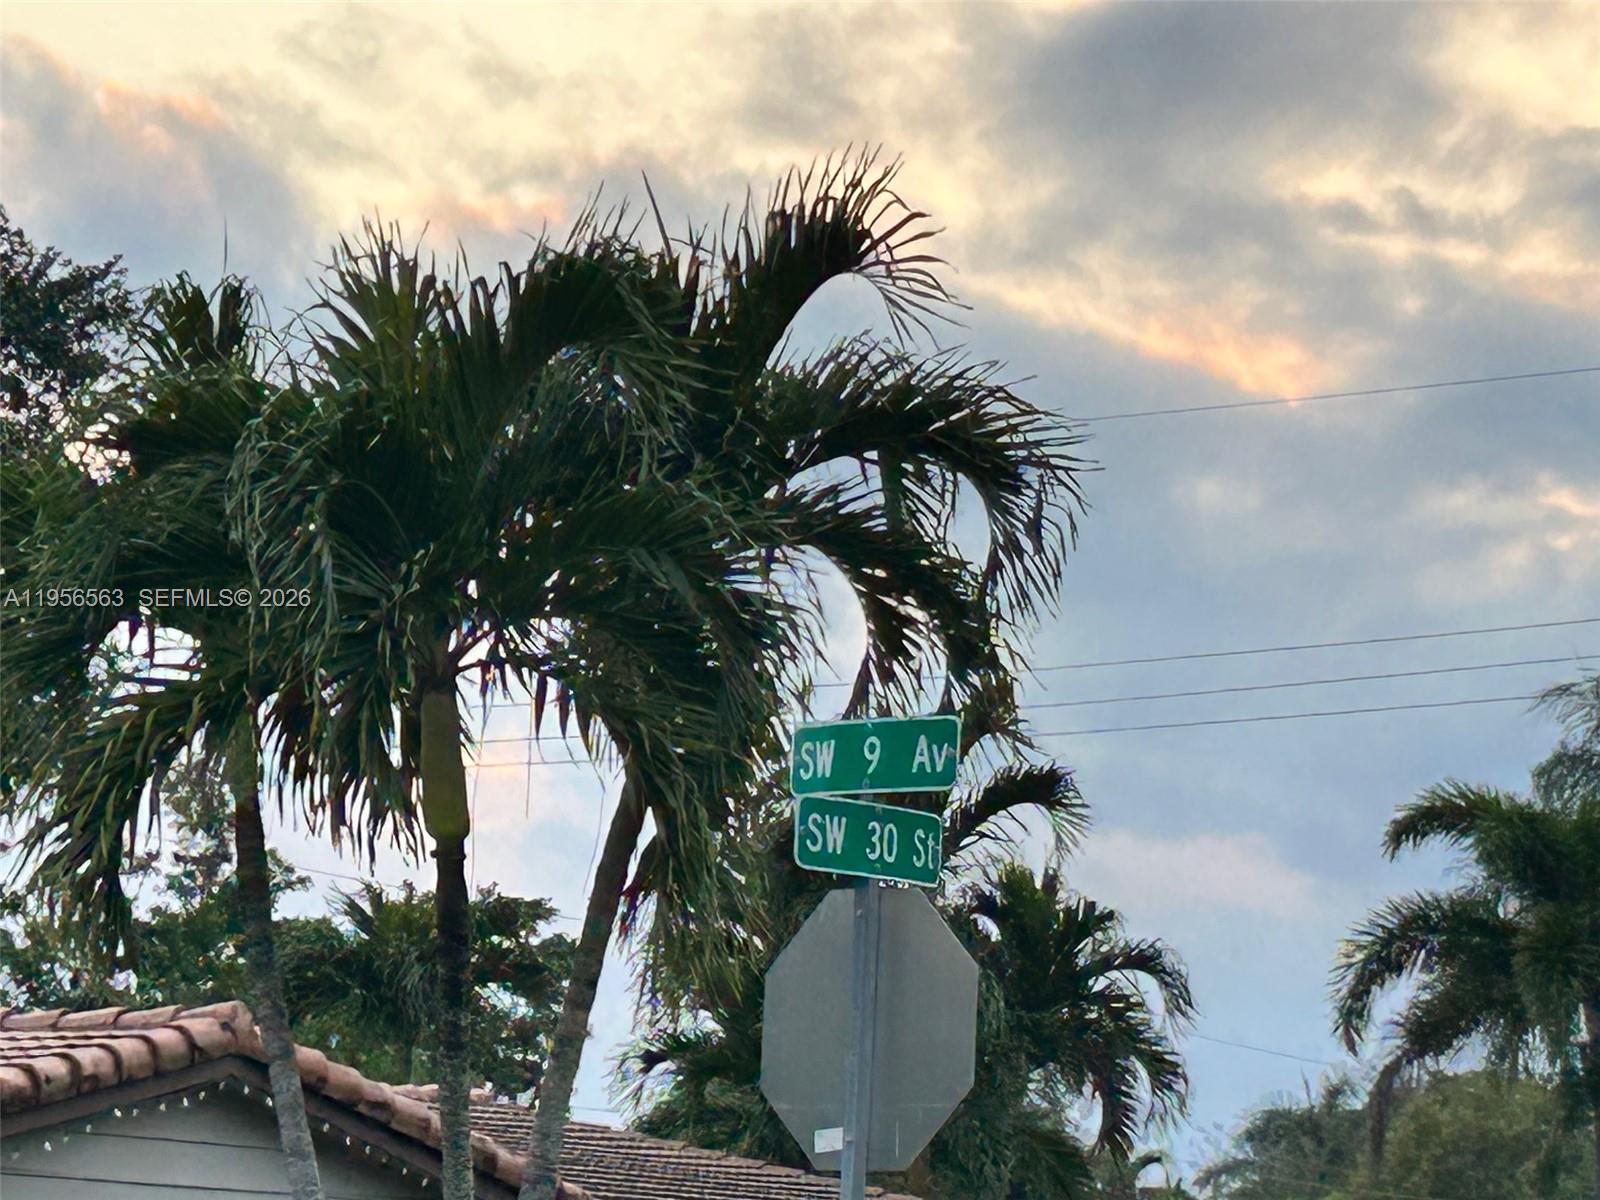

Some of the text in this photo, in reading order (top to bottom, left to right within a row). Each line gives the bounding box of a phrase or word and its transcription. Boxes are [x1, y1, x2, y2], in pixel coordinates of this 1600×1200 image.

[800, 734, 948, 780] SW 9 Av
[806, 813, 935, 869] SW 30 St
